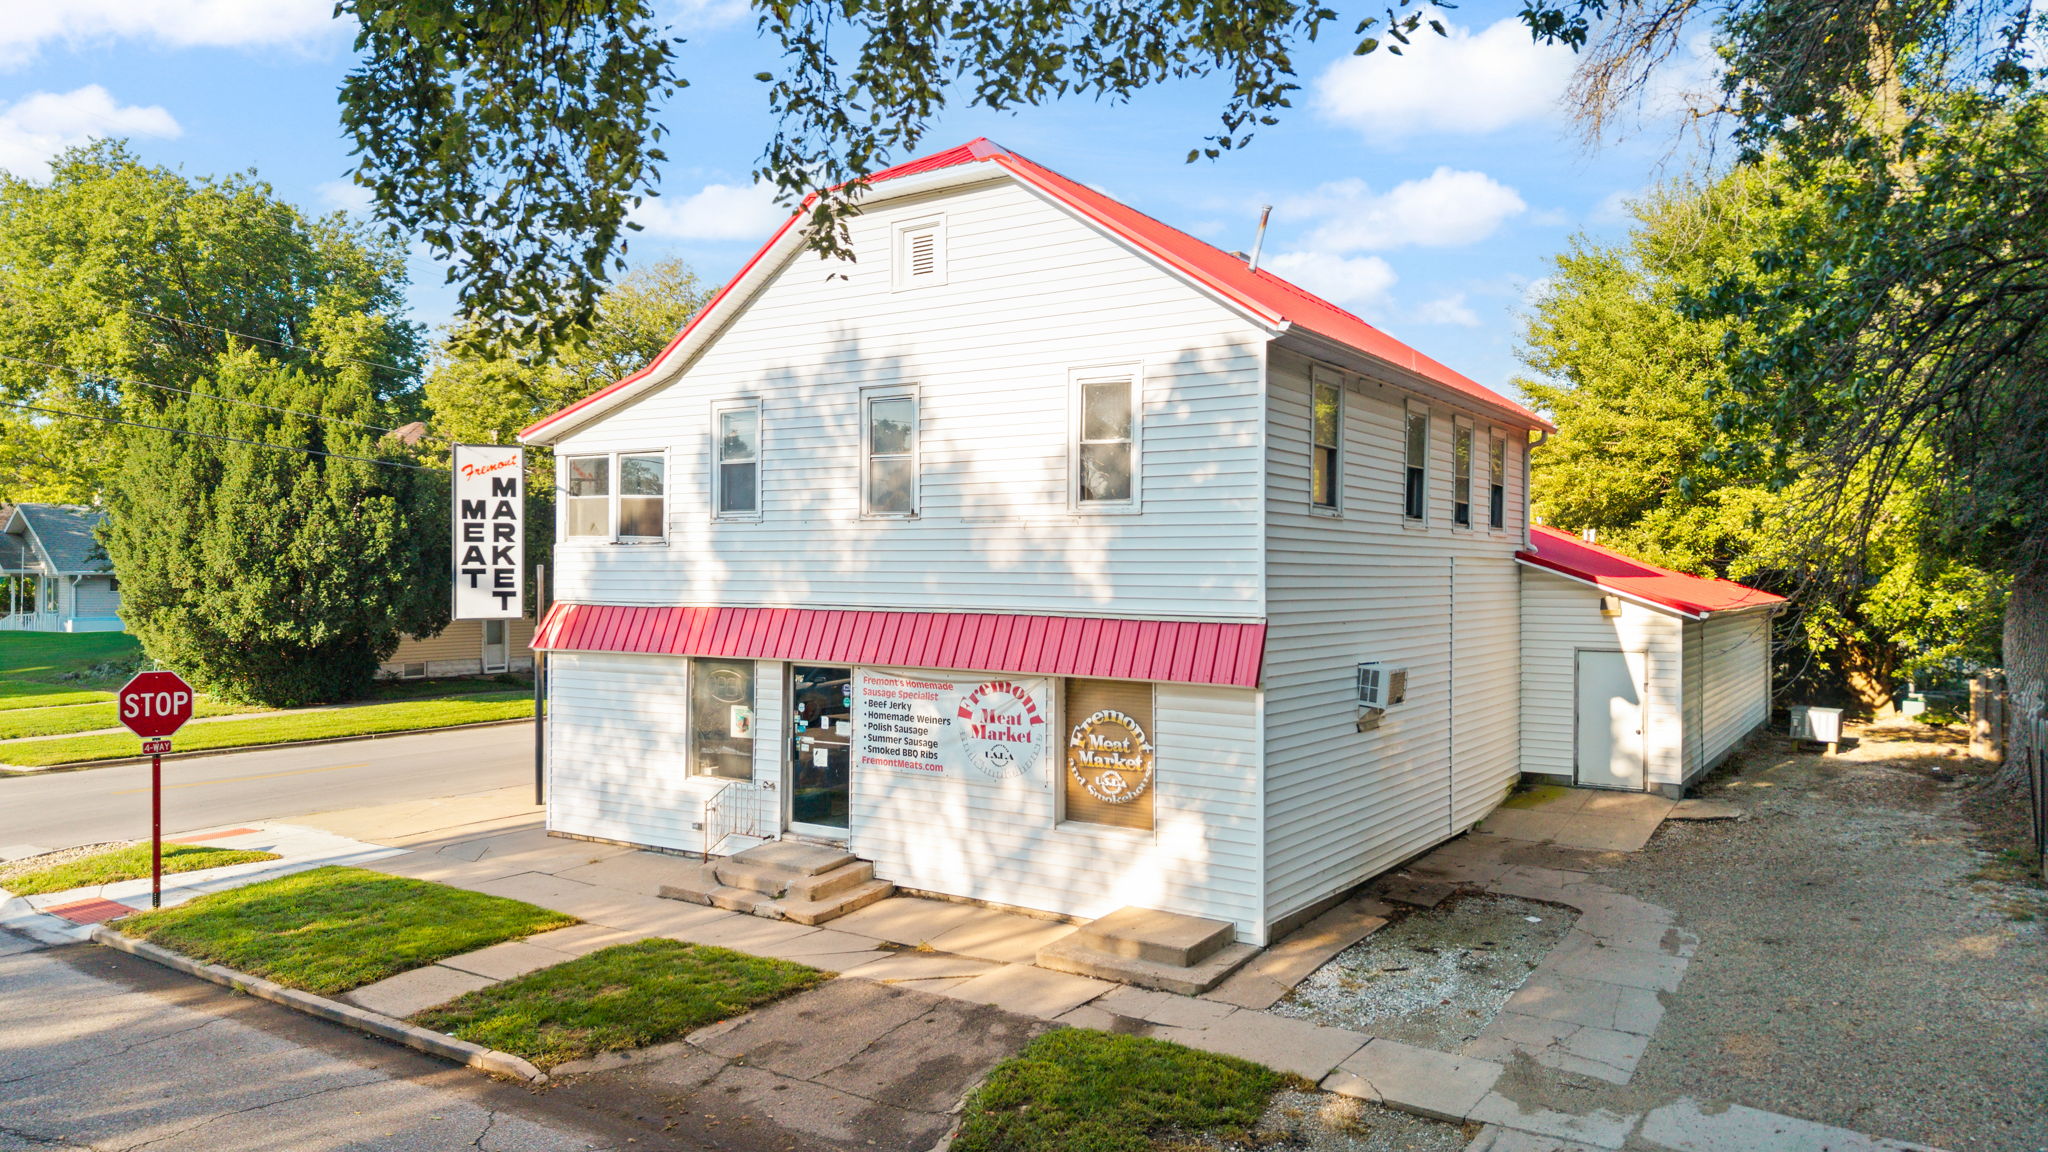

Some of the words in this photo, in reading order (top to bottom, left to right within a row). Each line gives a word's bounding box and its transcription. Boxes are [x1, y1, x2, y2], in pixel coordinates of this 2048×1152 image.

[461, 455, 517, 481] Fremont
[461, 499, 487, 588] MEAT
[492, 477, 517, 611] MARKET
[863, 676, 905, 688] Fremont's
[906, 679, 954, 691] Homemade
[863, 687, 897, 699] Sausage
[898, 690, 940, 701] Specialist
[123, 691, 189, 718] STOP
[868, 699, 887, 709] Beef
[889, 701, 912, 712] Jerky
[957, 680, 1045, 727] Fremont
[868, 711, 915, 723] Homemade
[916, 715, 951, 726] Weiners
[980, 708, 1022, 726] Meat
[867, 722, 893, 732] Polish
[894, 724, 929, 736] Sausage
[971, 724, 1032, 743] Market
[1070, 709, 1154, 753] Fremont
[144, 742, 170, 752] 4-WAY
[867, 733, 902, 744] Summer
[904, 737, 939, 749] Sausage
[1089, 734, 1131, 753] Meat
[867, 745, 901, 756] Smoked
[902, 749, 918, 758] BBQ
[920, 750, 938, 760] Ribs
[1079, 750, 1143, 771] Market
[861, 756, 944, 772] FremontMeats.com
[1068, 757, 1086, 786] and
[1087, 761, 1152, 803] Smokehouse
